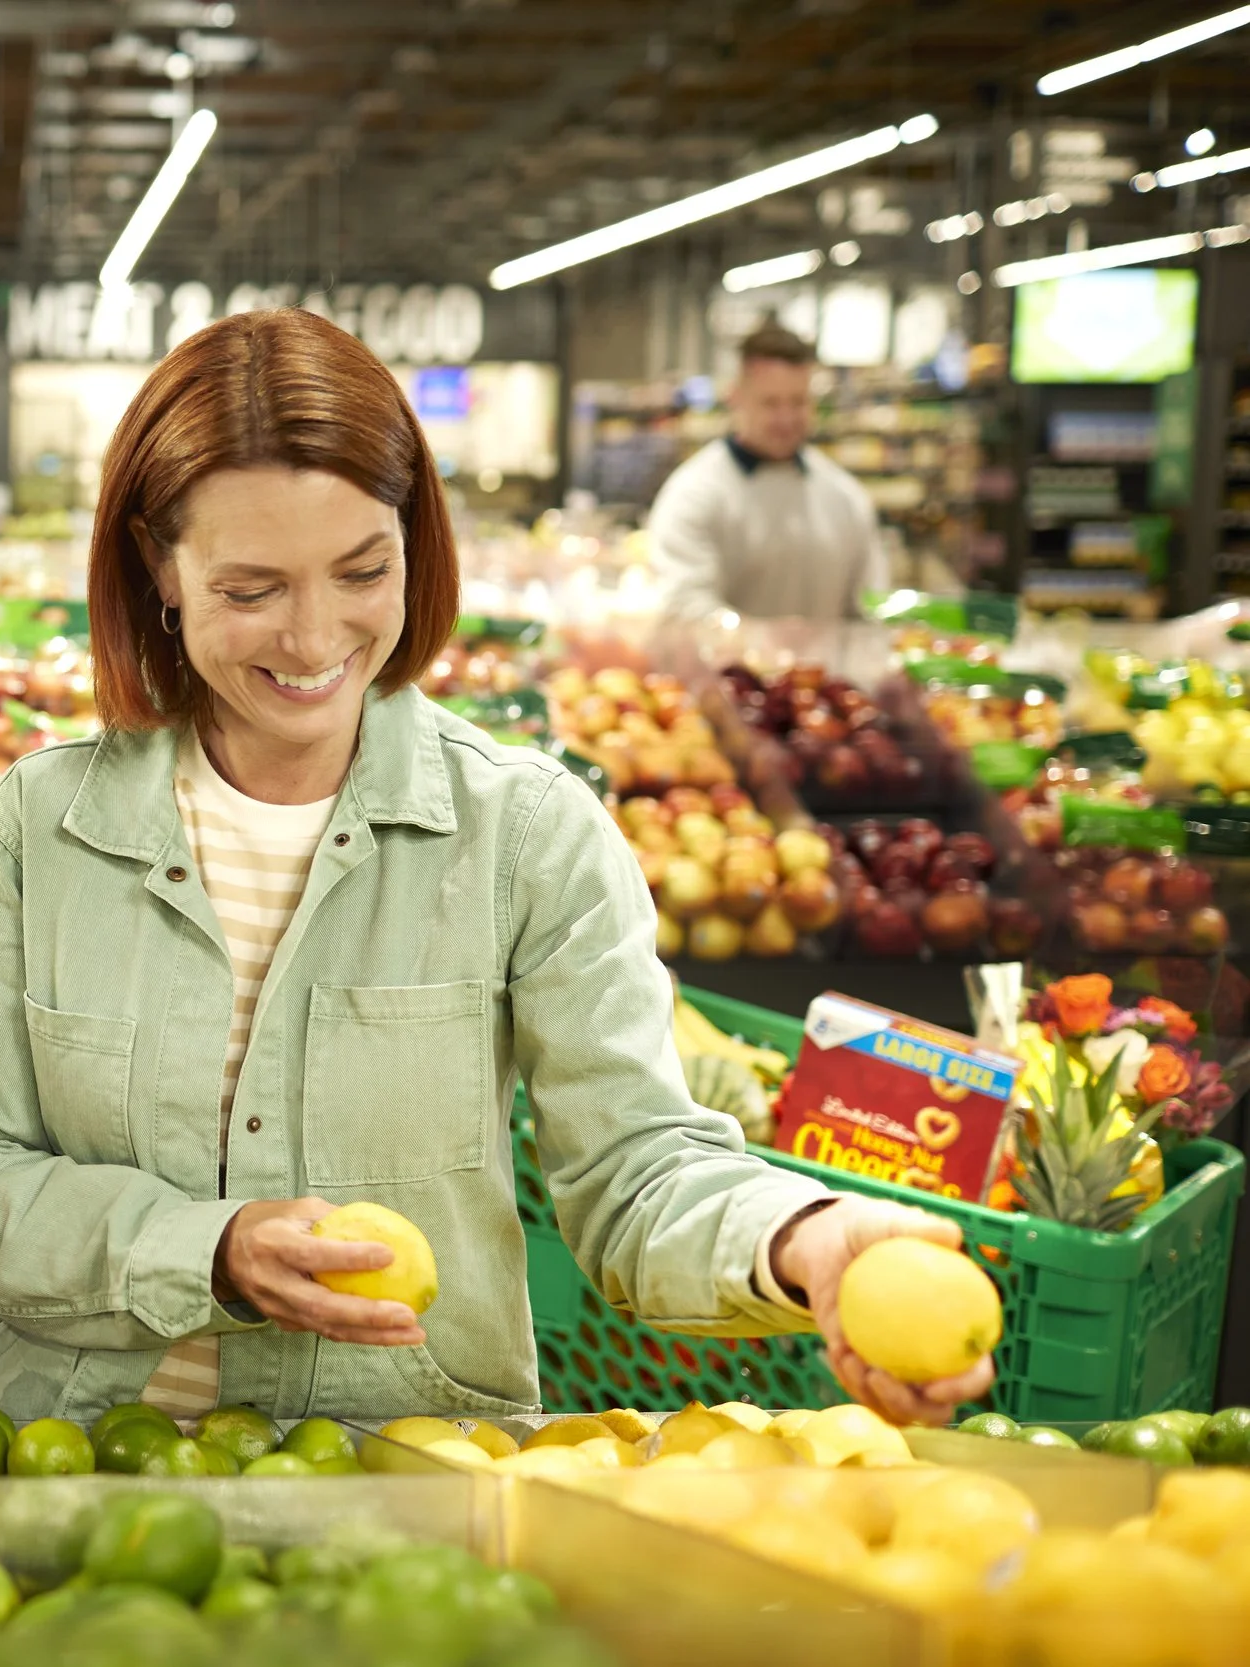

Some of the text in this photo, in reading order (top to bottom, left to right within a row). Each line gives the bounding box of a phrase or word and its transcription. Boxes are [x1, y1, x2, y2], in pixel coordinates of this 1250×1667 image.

[9, 281, 165, 359] MEAT
[873, 1034, 944, 1074] LARGE
[946, 1059, 996, 1092] SIZE
[852, 1124, 945, 1174] Honey Nut
